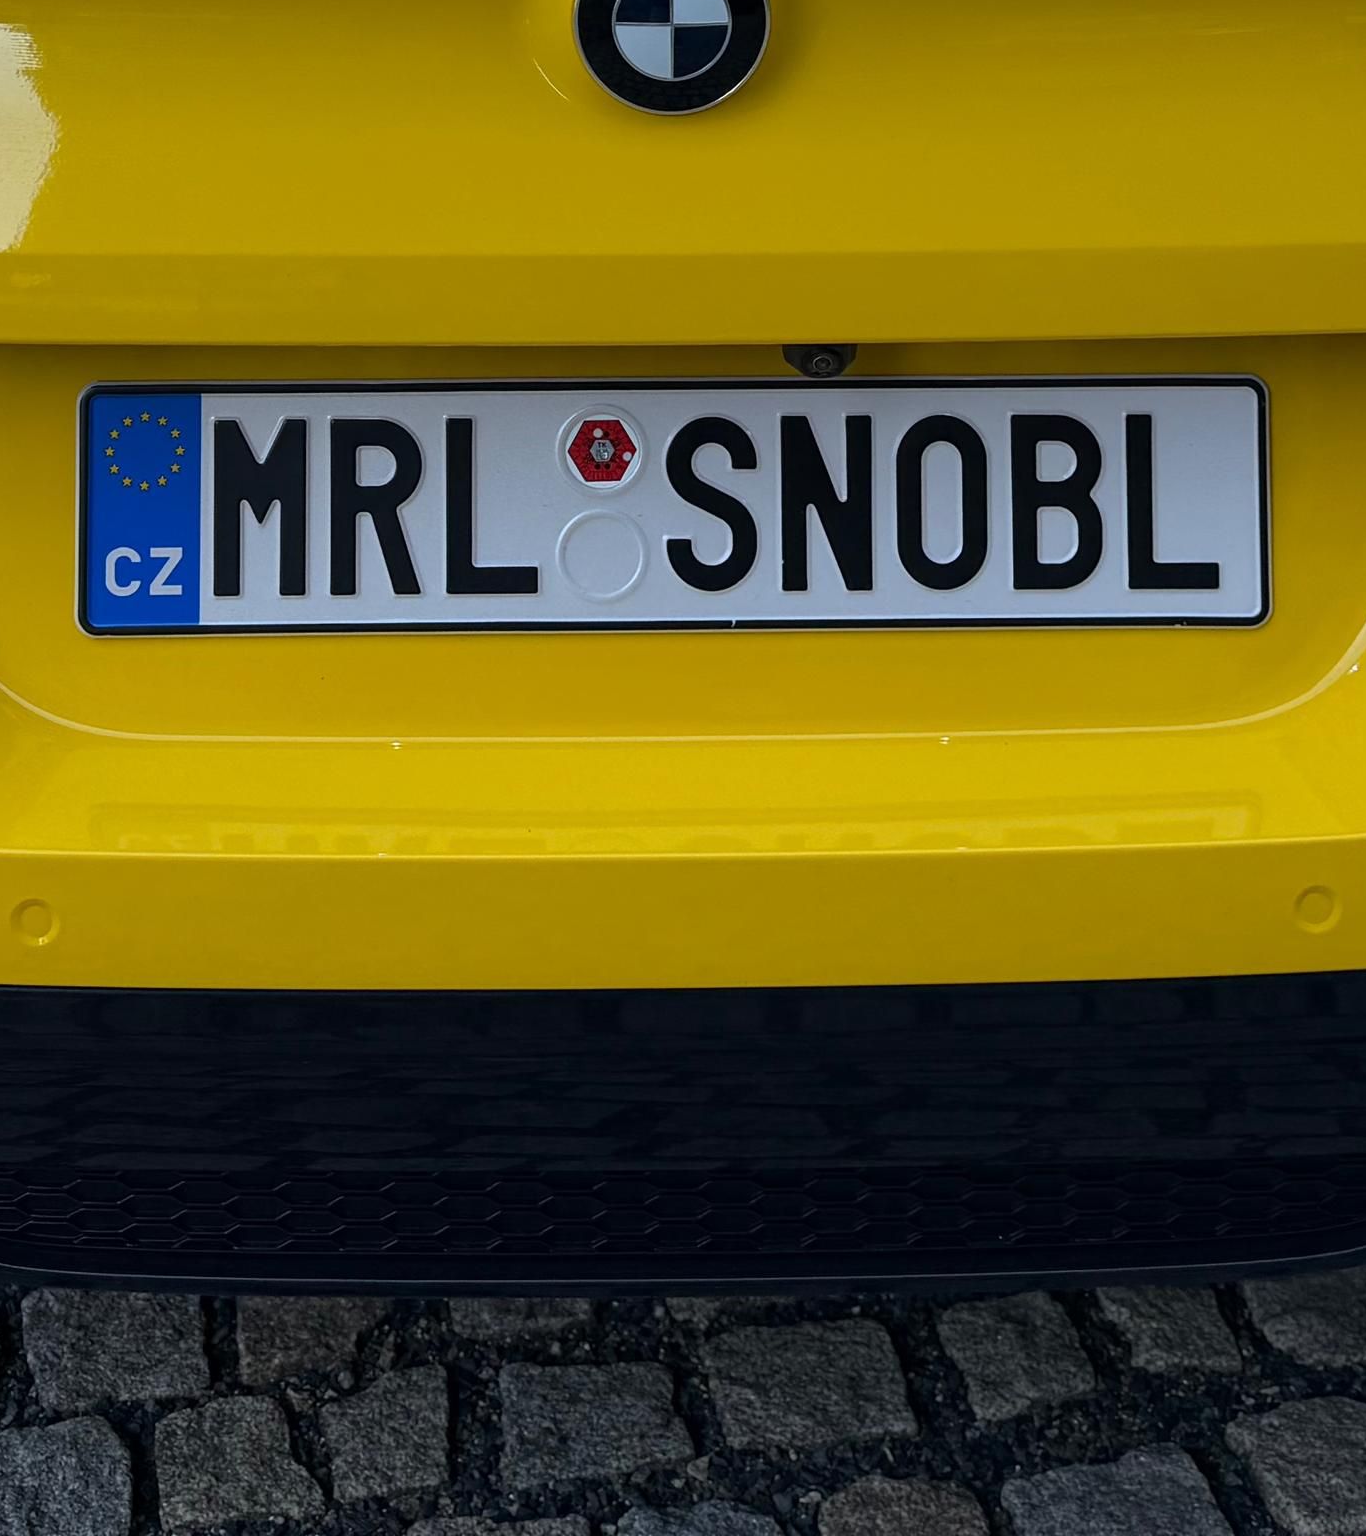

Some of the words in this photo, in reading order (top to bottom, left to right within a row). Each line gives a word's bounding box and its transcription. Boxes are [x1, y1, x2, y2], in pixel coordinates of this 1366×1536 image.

[213, 416, 539, 597] MRL
[665, 413, 1220, 593] SNOBL
[104, 546, 184, 598] CZ
